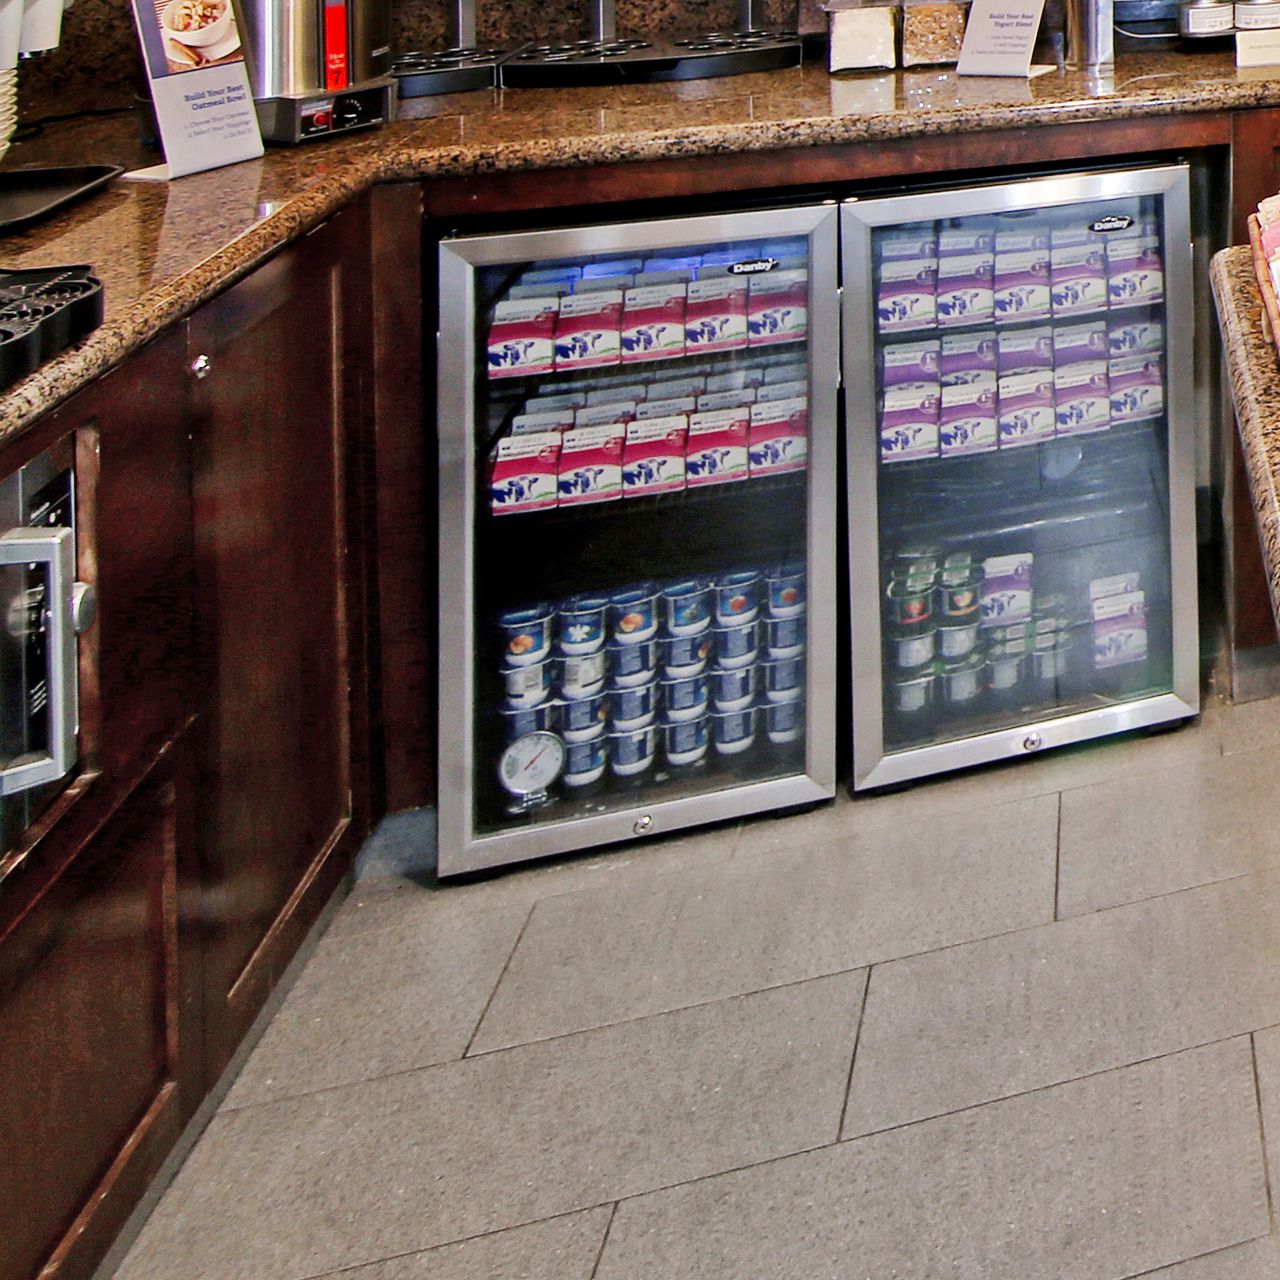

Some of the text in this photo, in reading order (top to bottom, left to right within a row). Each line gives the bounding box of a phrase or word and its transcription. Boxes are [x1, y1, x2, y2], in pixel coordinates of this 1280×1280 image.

[184, 91, 206, 102] Build
[192, 98, 225, 110] Oatmeal
[733, 260, 773, 273] Danby
